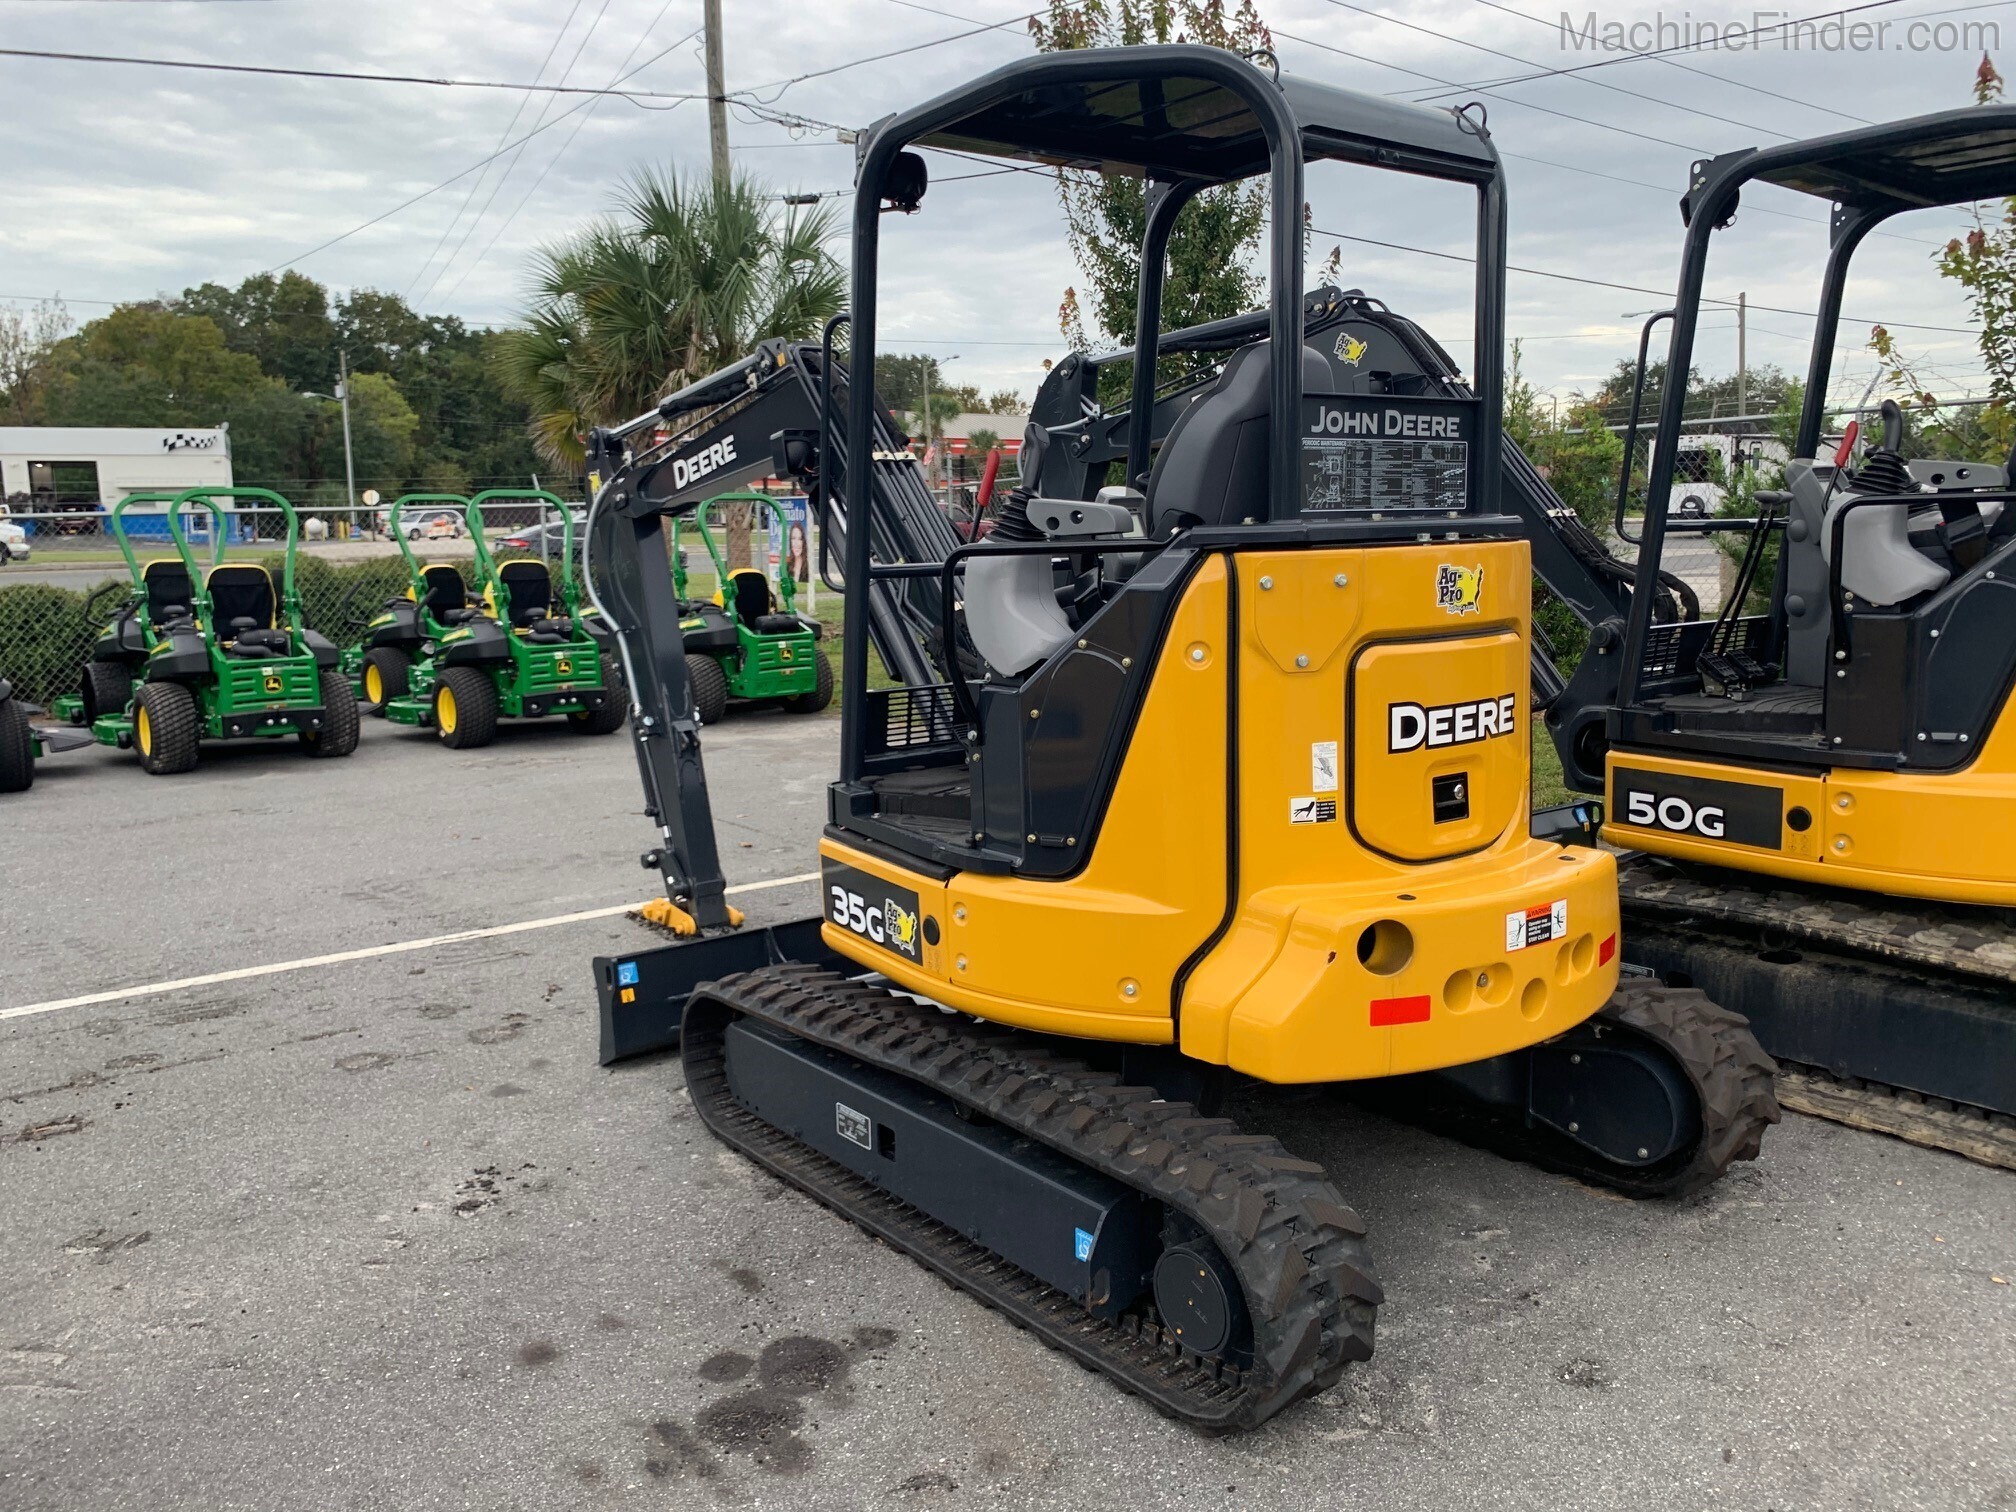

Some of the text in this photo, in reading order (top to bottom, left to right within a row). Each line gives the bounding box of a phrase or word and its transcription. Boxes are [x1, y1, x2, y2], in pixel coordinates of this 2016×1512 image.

[1310, 405, 1460, 438] JOHN DEERE
[672, 434, 737, 490] DEERE
[1438, 566, 1463, 589] Ag-
[1438, 585, 1463, 604] Pro
[1389, 694, 1515, 754] DEERE
[1628, 791, 1725, 837] 50G
[831, 885, 885, 943] 35G
